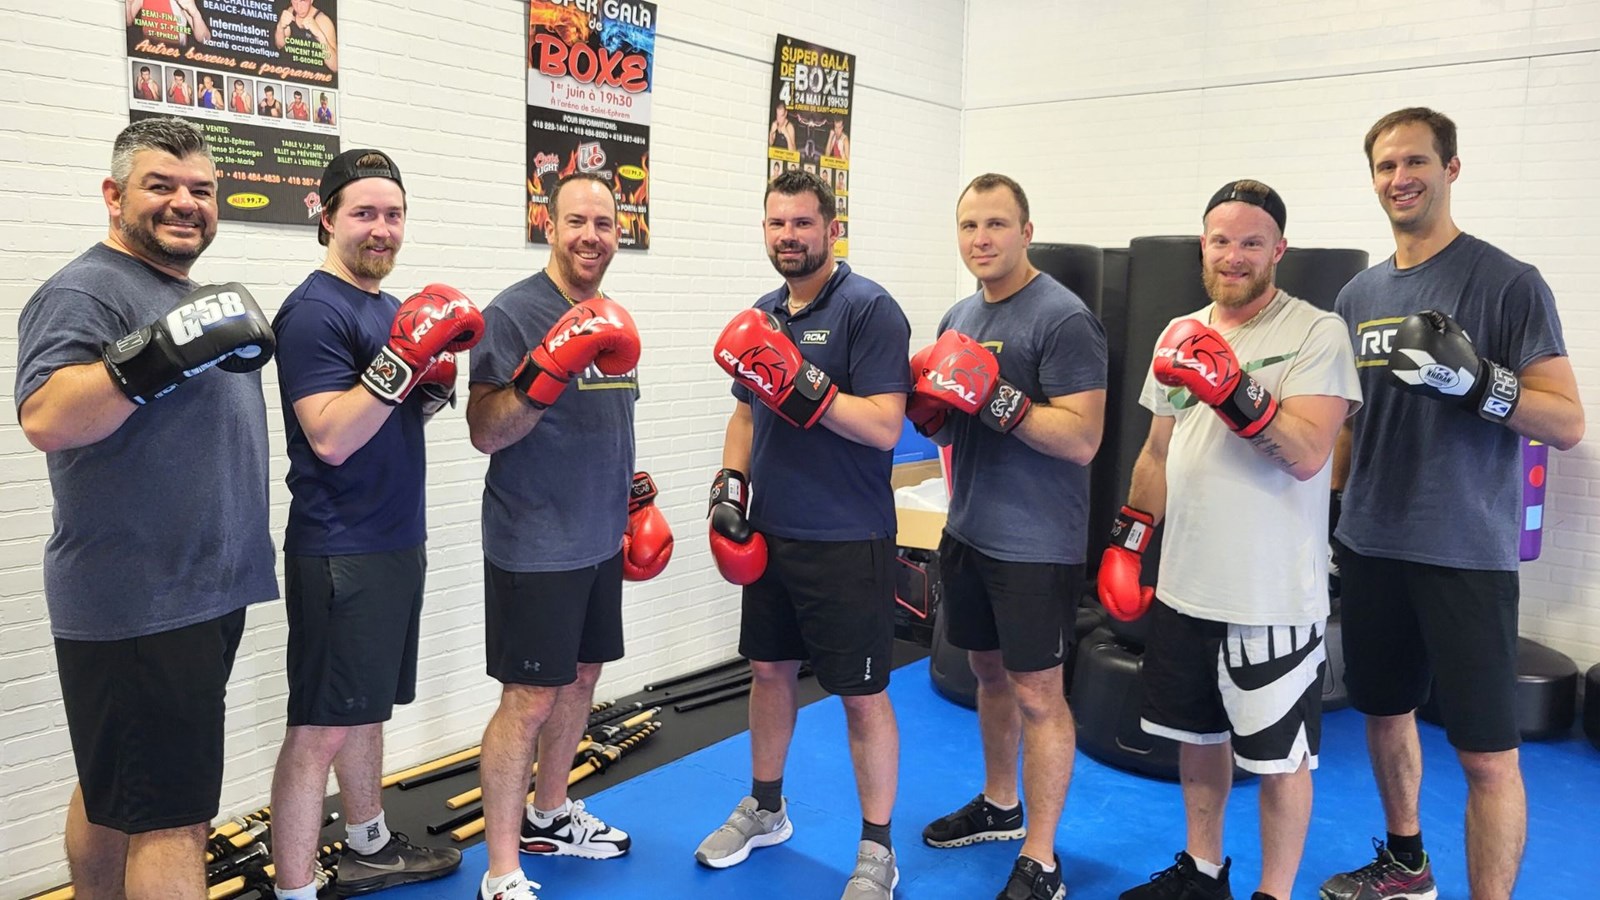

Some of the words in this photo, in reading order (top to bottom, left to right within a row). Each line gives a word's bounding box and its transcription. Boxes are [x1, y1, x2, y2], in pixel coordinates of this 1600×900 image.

[203, 1, 278, 22] BEAUCE-AMIANTE
[588, 18, 603, 31] de
[209, 17, 270, 37] Intermission:
[212, 30, 269, 46] Démonstration
[135, 39, 181, 57] Autres
[185, 47, 237, 67] boxeurs
[240, 61, 257, 70] au
[258, 62, 332, 82] programme
[203, 38, 230, 49] karaté
[231, 43, 280, 58] acrobatique
[781, 46, 819, 66] SUPER
[535, 33, 649, 94] BOXE
[780, 62, 795, 78] DE
[795, 63, 850, 97] BOXE
[566, 83, 586, 99] juin
[589, 89, 596, 101] à
[600, 91, 633, 108] 19h30
[795, 91, 805, 104] 24
[806, 93, 821, 106] MAI
[537, 163, 559, 177] LIGHT
[308, 203, 323, 218] LIG
[166, 291, 246, 346] G58
[411, 299, 476, 344] RIVAL
[548, 316, 625, 354] RIVAL
[1360, 328, 1399, 356] RC
[366, 366, 394, 393] IVAL
[718, 349, 774, 396] RIVAL
[1156, 347, 1218, 387] RIVAL
[922, 368, 977, 405] RIVAL
